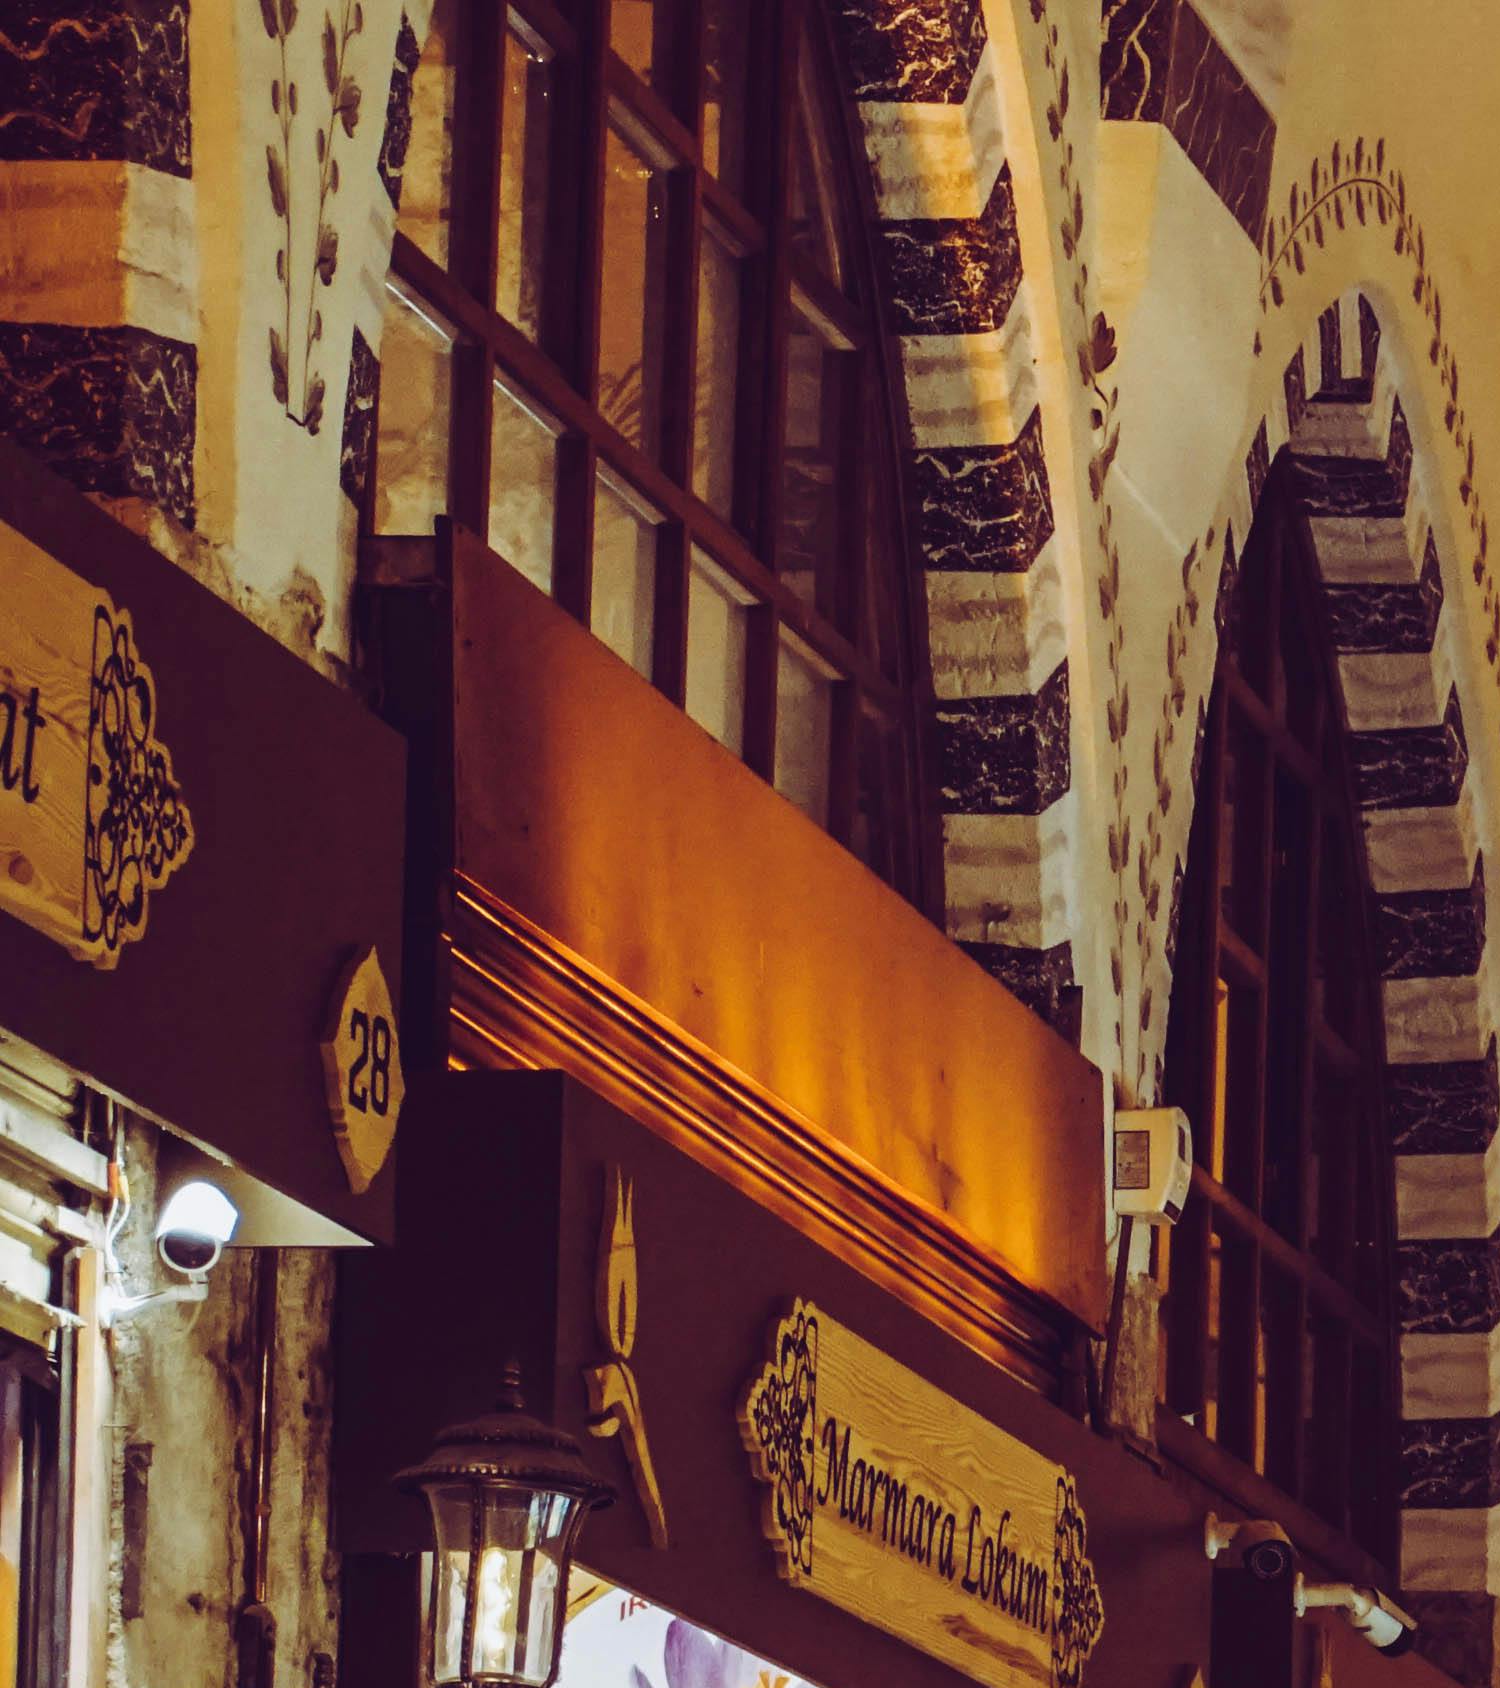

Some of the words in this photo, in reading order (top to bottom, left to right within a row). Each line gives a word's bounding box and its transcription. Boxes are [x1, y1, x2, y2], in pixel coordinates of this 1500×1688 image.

[349, 1007, 391, 1117] 28
[816, 1416, 956, 1582] Marmara
[960, 1504, 1049, 1634] Lokum
